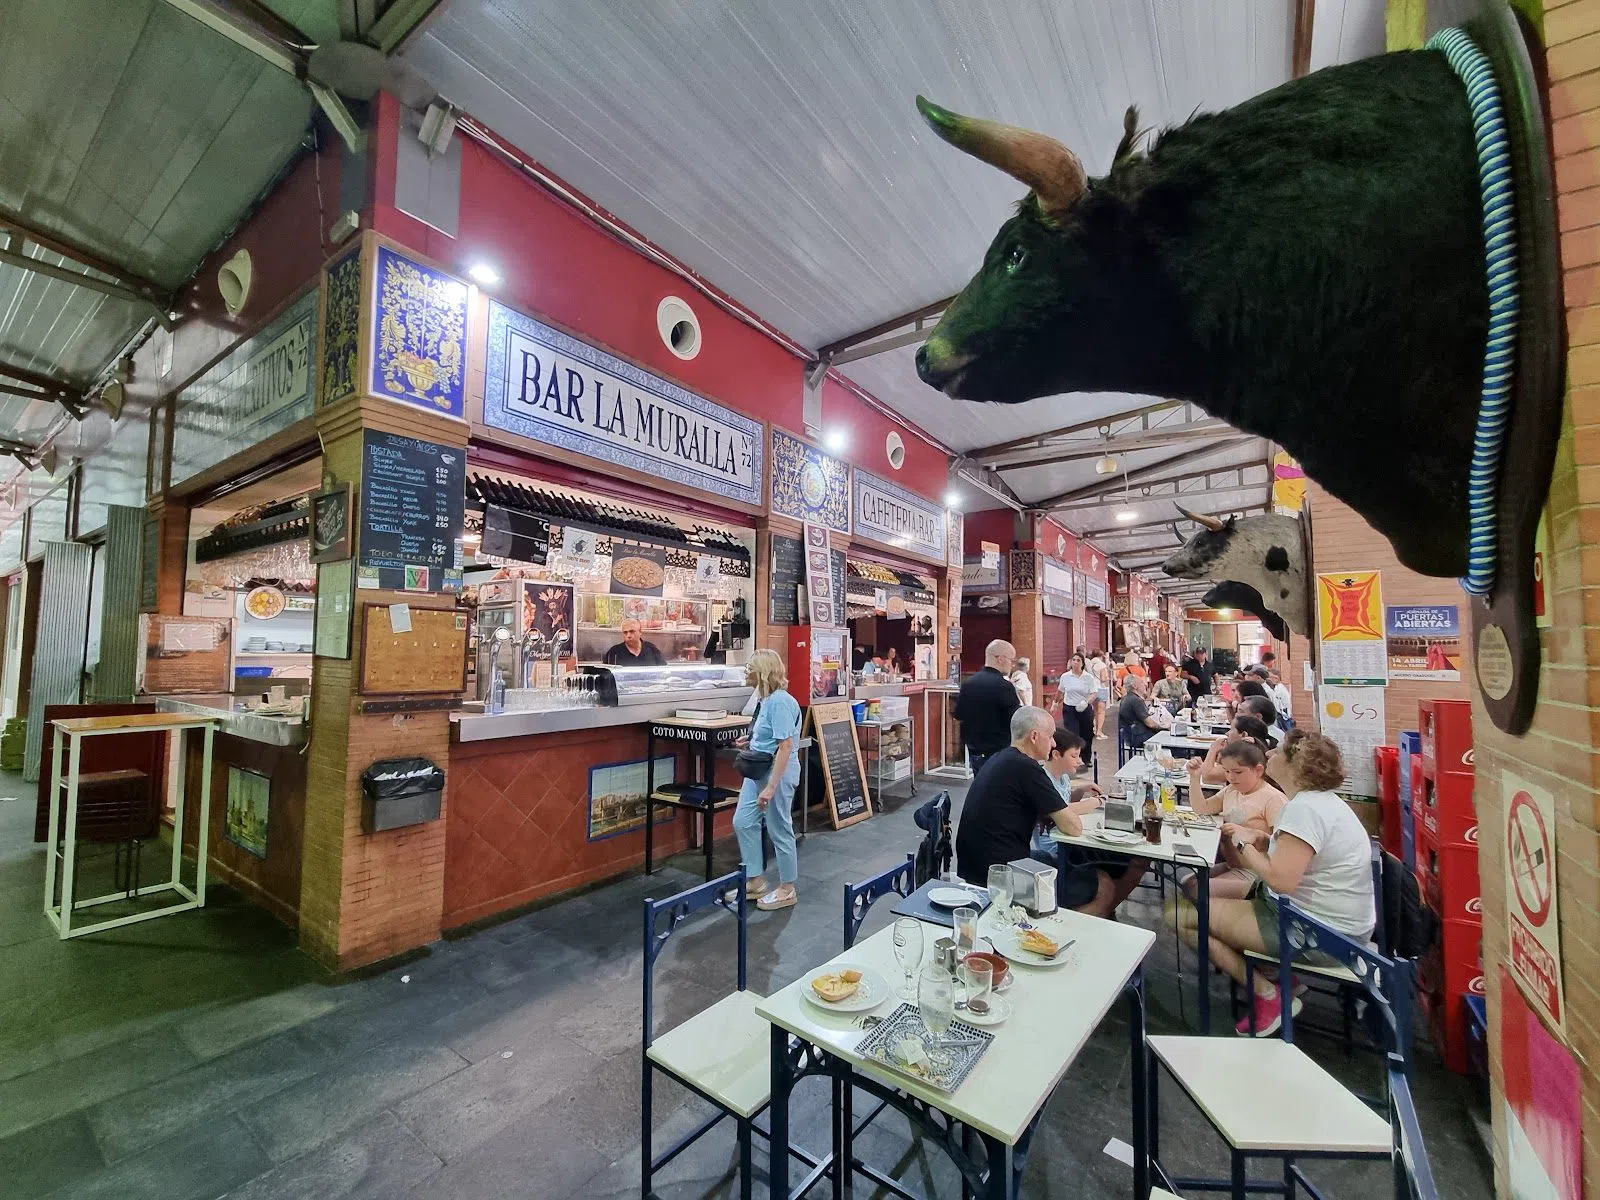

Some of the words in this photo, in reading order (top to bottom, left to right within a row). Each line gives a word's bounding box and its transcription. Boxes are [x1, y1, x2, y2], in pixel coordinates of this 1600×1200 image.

[517, 349, 585, 424] BAR
[592, 379, 628, 439] LA
[633, 396, 738, 477] MURALLA
[741, 452, 753, 468] 72
[1394, 620, 1452, 628] ABIERTAS
[1400, 613, 1444, 621] PUERTAS
[652, 726, 675, 738] COTO
[676, 727, 707, 742] MAYOR
[717, 728, 739, 742] COTO
